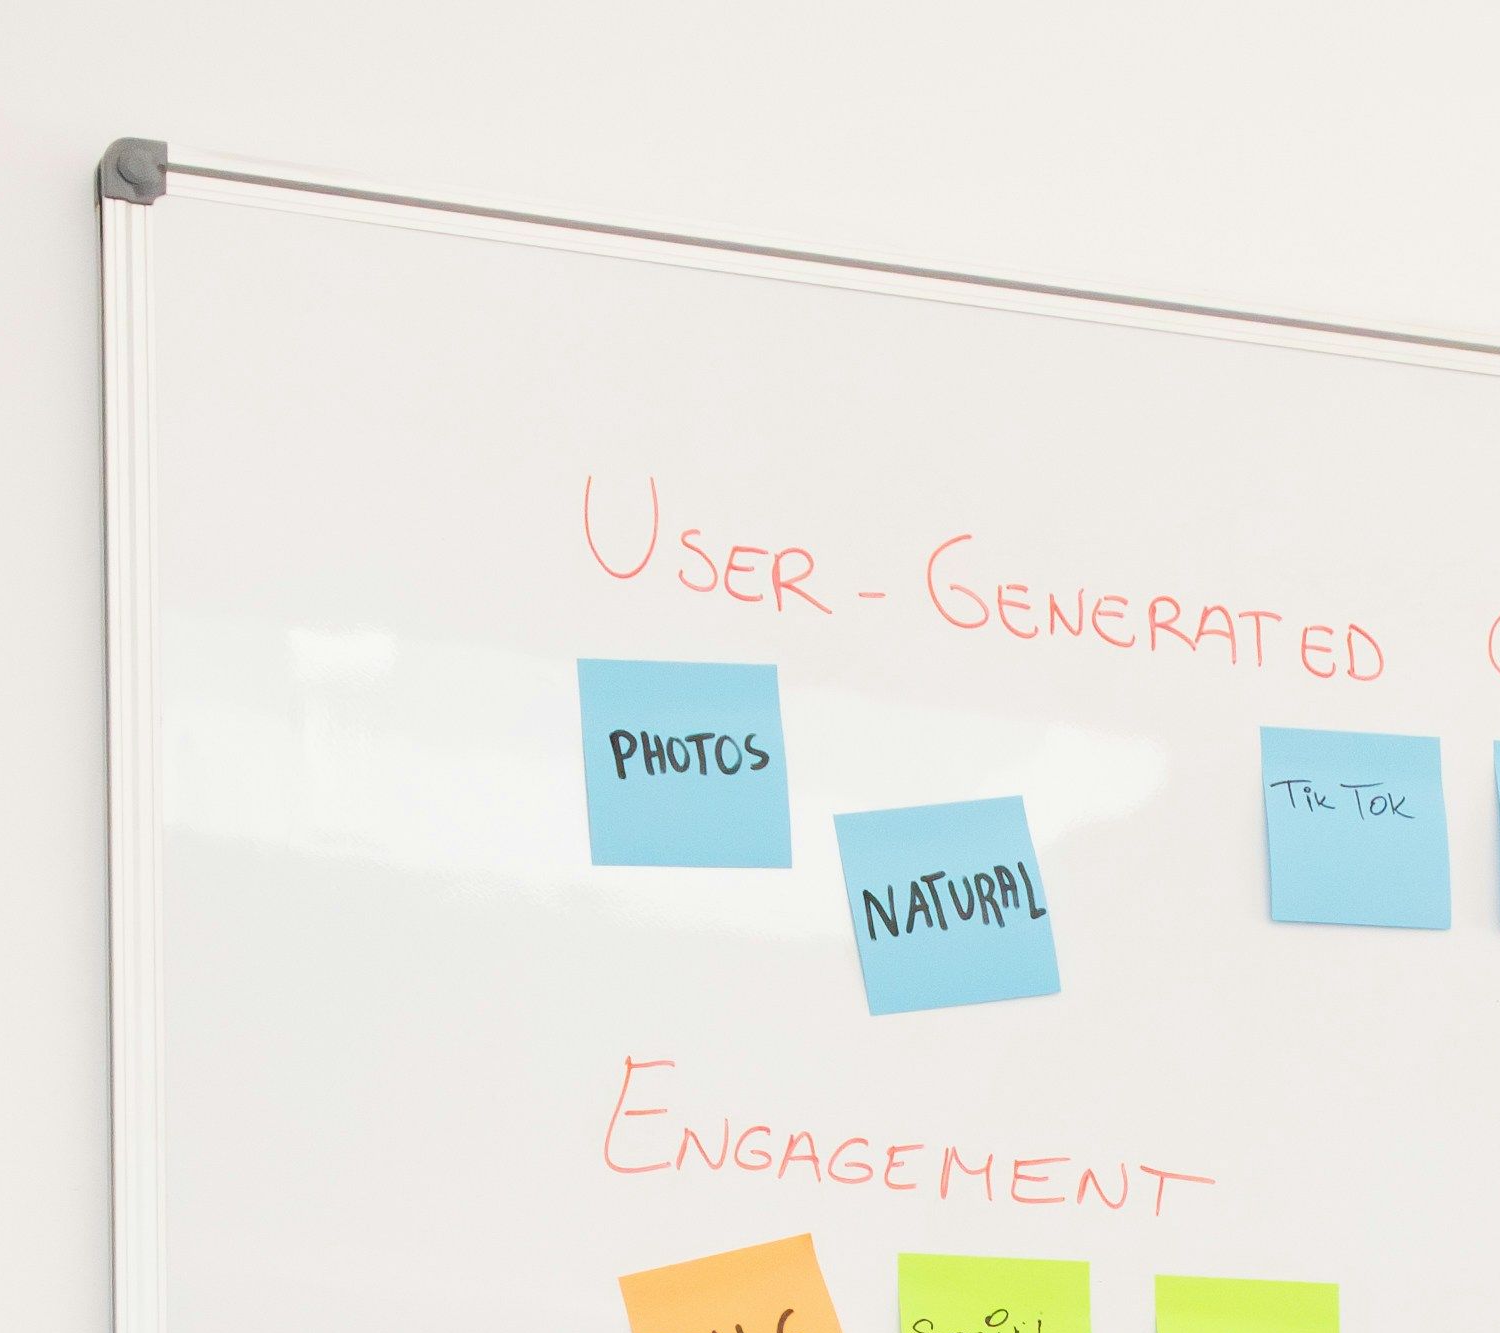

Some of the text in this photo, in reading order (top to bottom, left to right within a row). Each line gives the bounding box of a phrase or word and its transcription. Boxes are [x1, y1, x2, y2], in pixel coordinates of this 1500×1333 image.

[610, 731, 770, 780] PHOTOS
[864, 863, 1047, 941] NATURAL
[604, 1056, 1216, 1217] ENGAGEMENT
